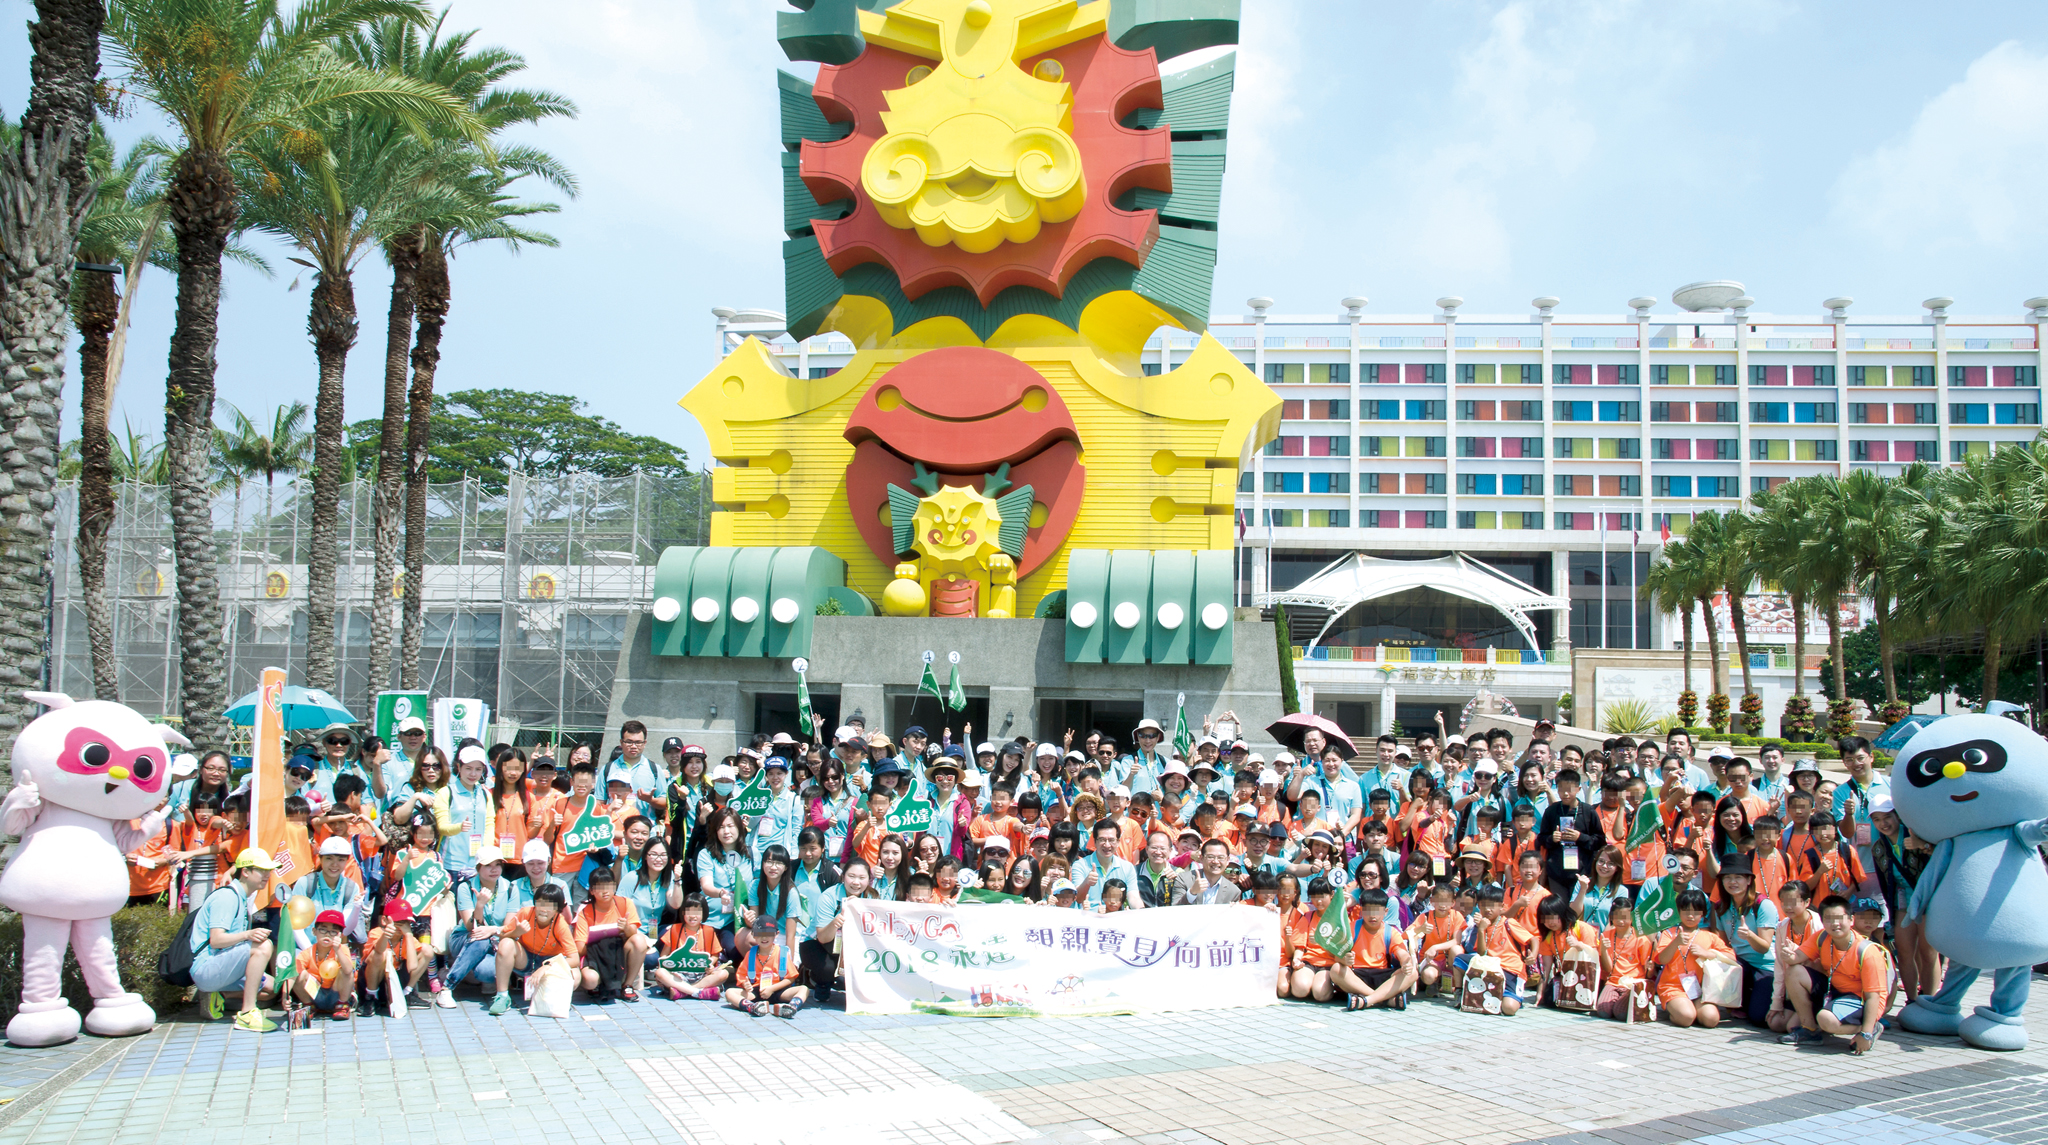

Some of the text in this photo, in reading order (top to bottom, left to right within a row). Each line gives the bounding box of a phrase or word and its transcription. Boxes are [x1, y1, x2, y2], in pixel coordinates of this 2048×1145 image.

[1402, 666, 1497, 681] 福容大飯店
